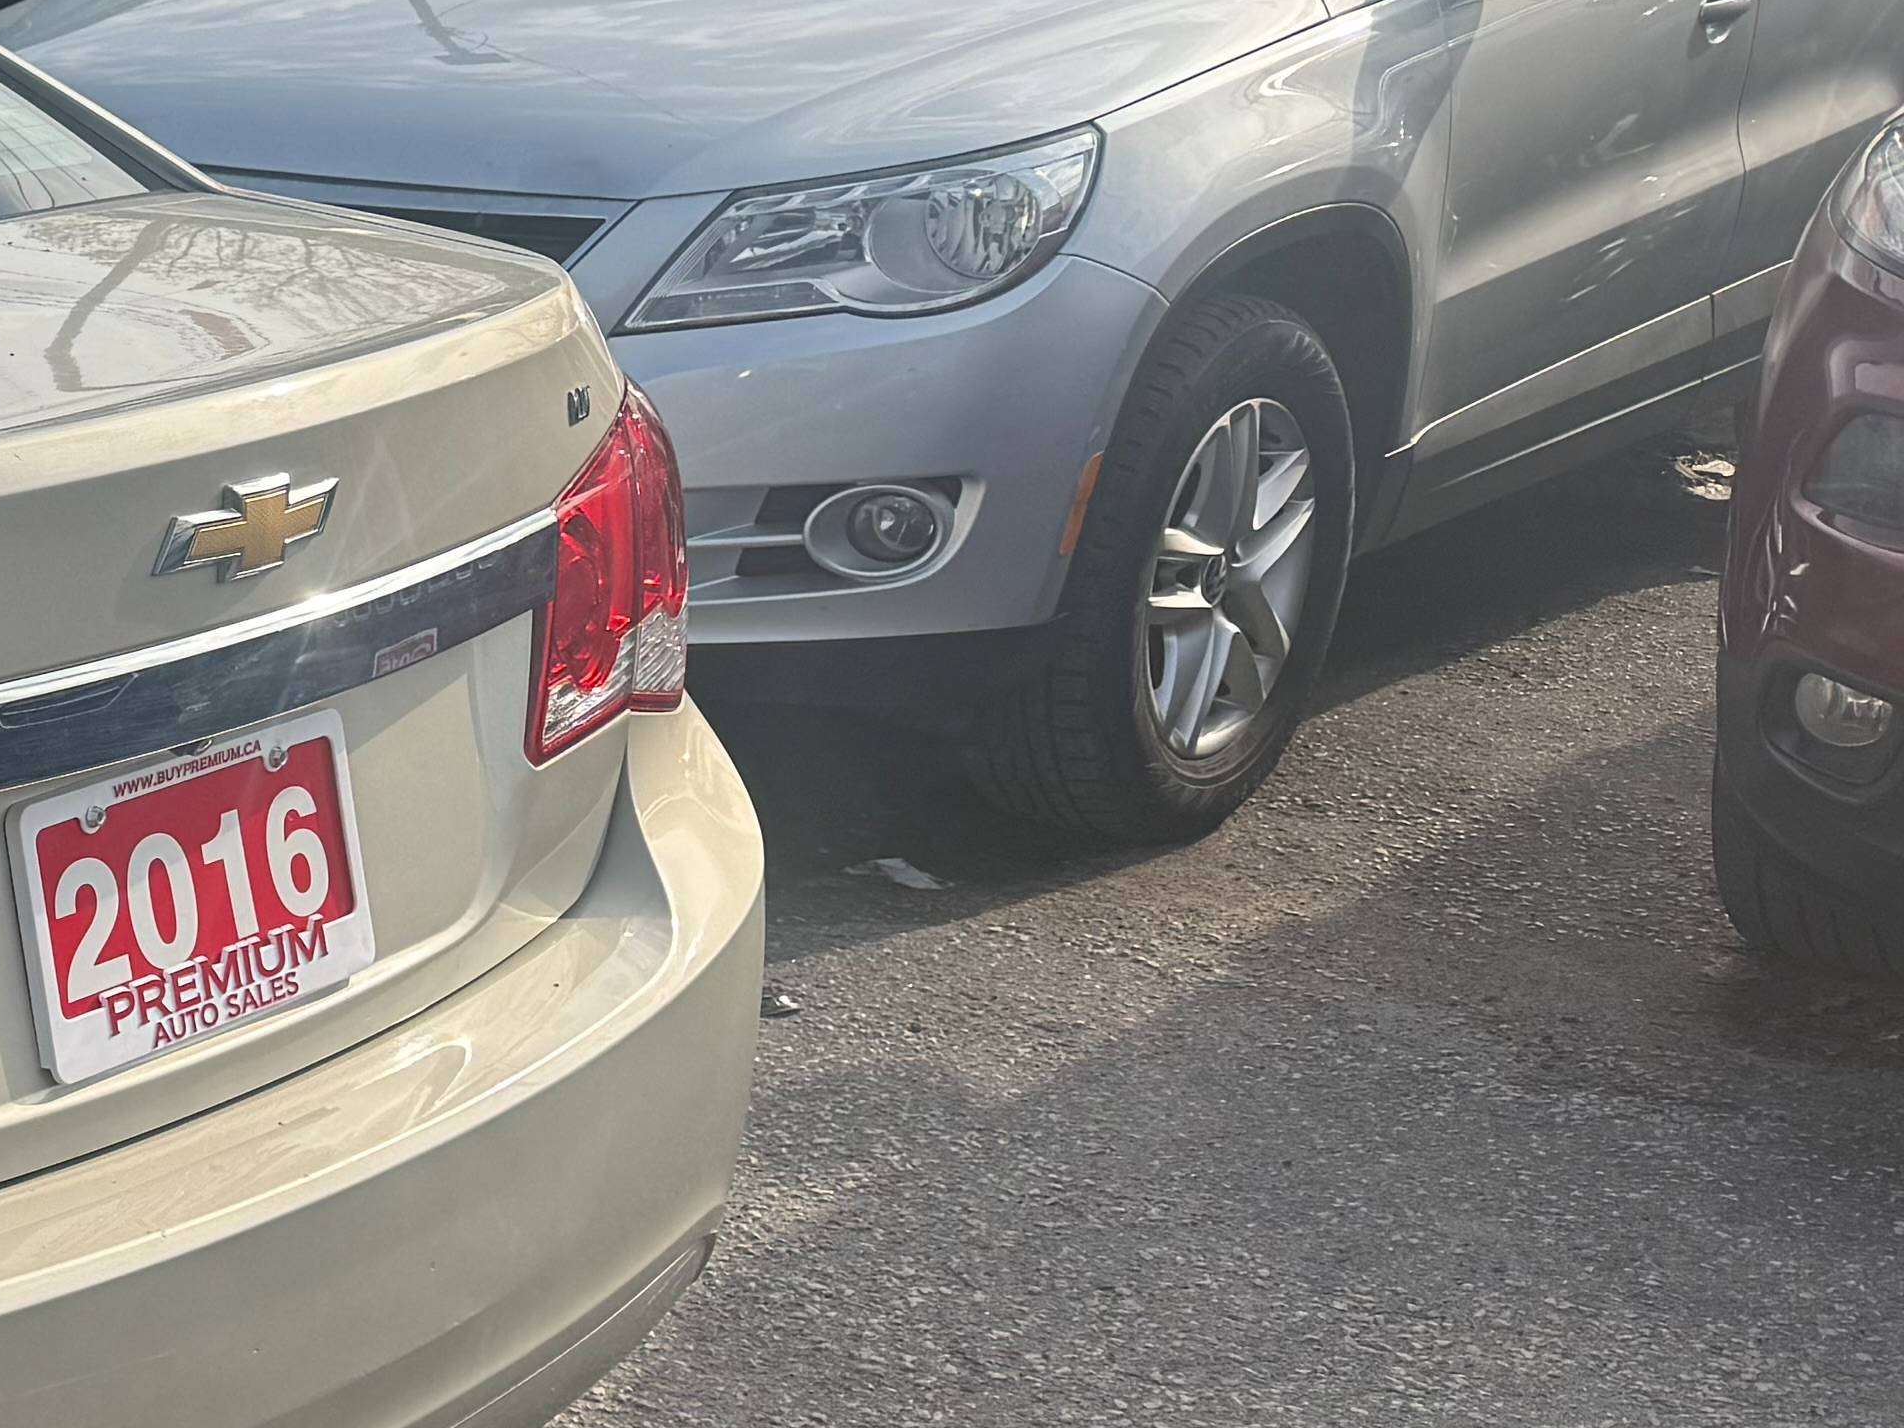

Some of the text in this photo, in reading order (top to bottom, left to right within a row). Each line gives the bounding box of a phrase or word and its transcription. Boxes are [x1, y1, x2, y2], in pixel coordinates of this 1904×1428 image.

[112, 739, 262, 798] WWW.BUYPREMIUM.CA
[54, 785, 330, 1004] 2016
[100, 914, 329, 1038] PREMIUM
[154, 971, 300, 1049] AUTO SALES
